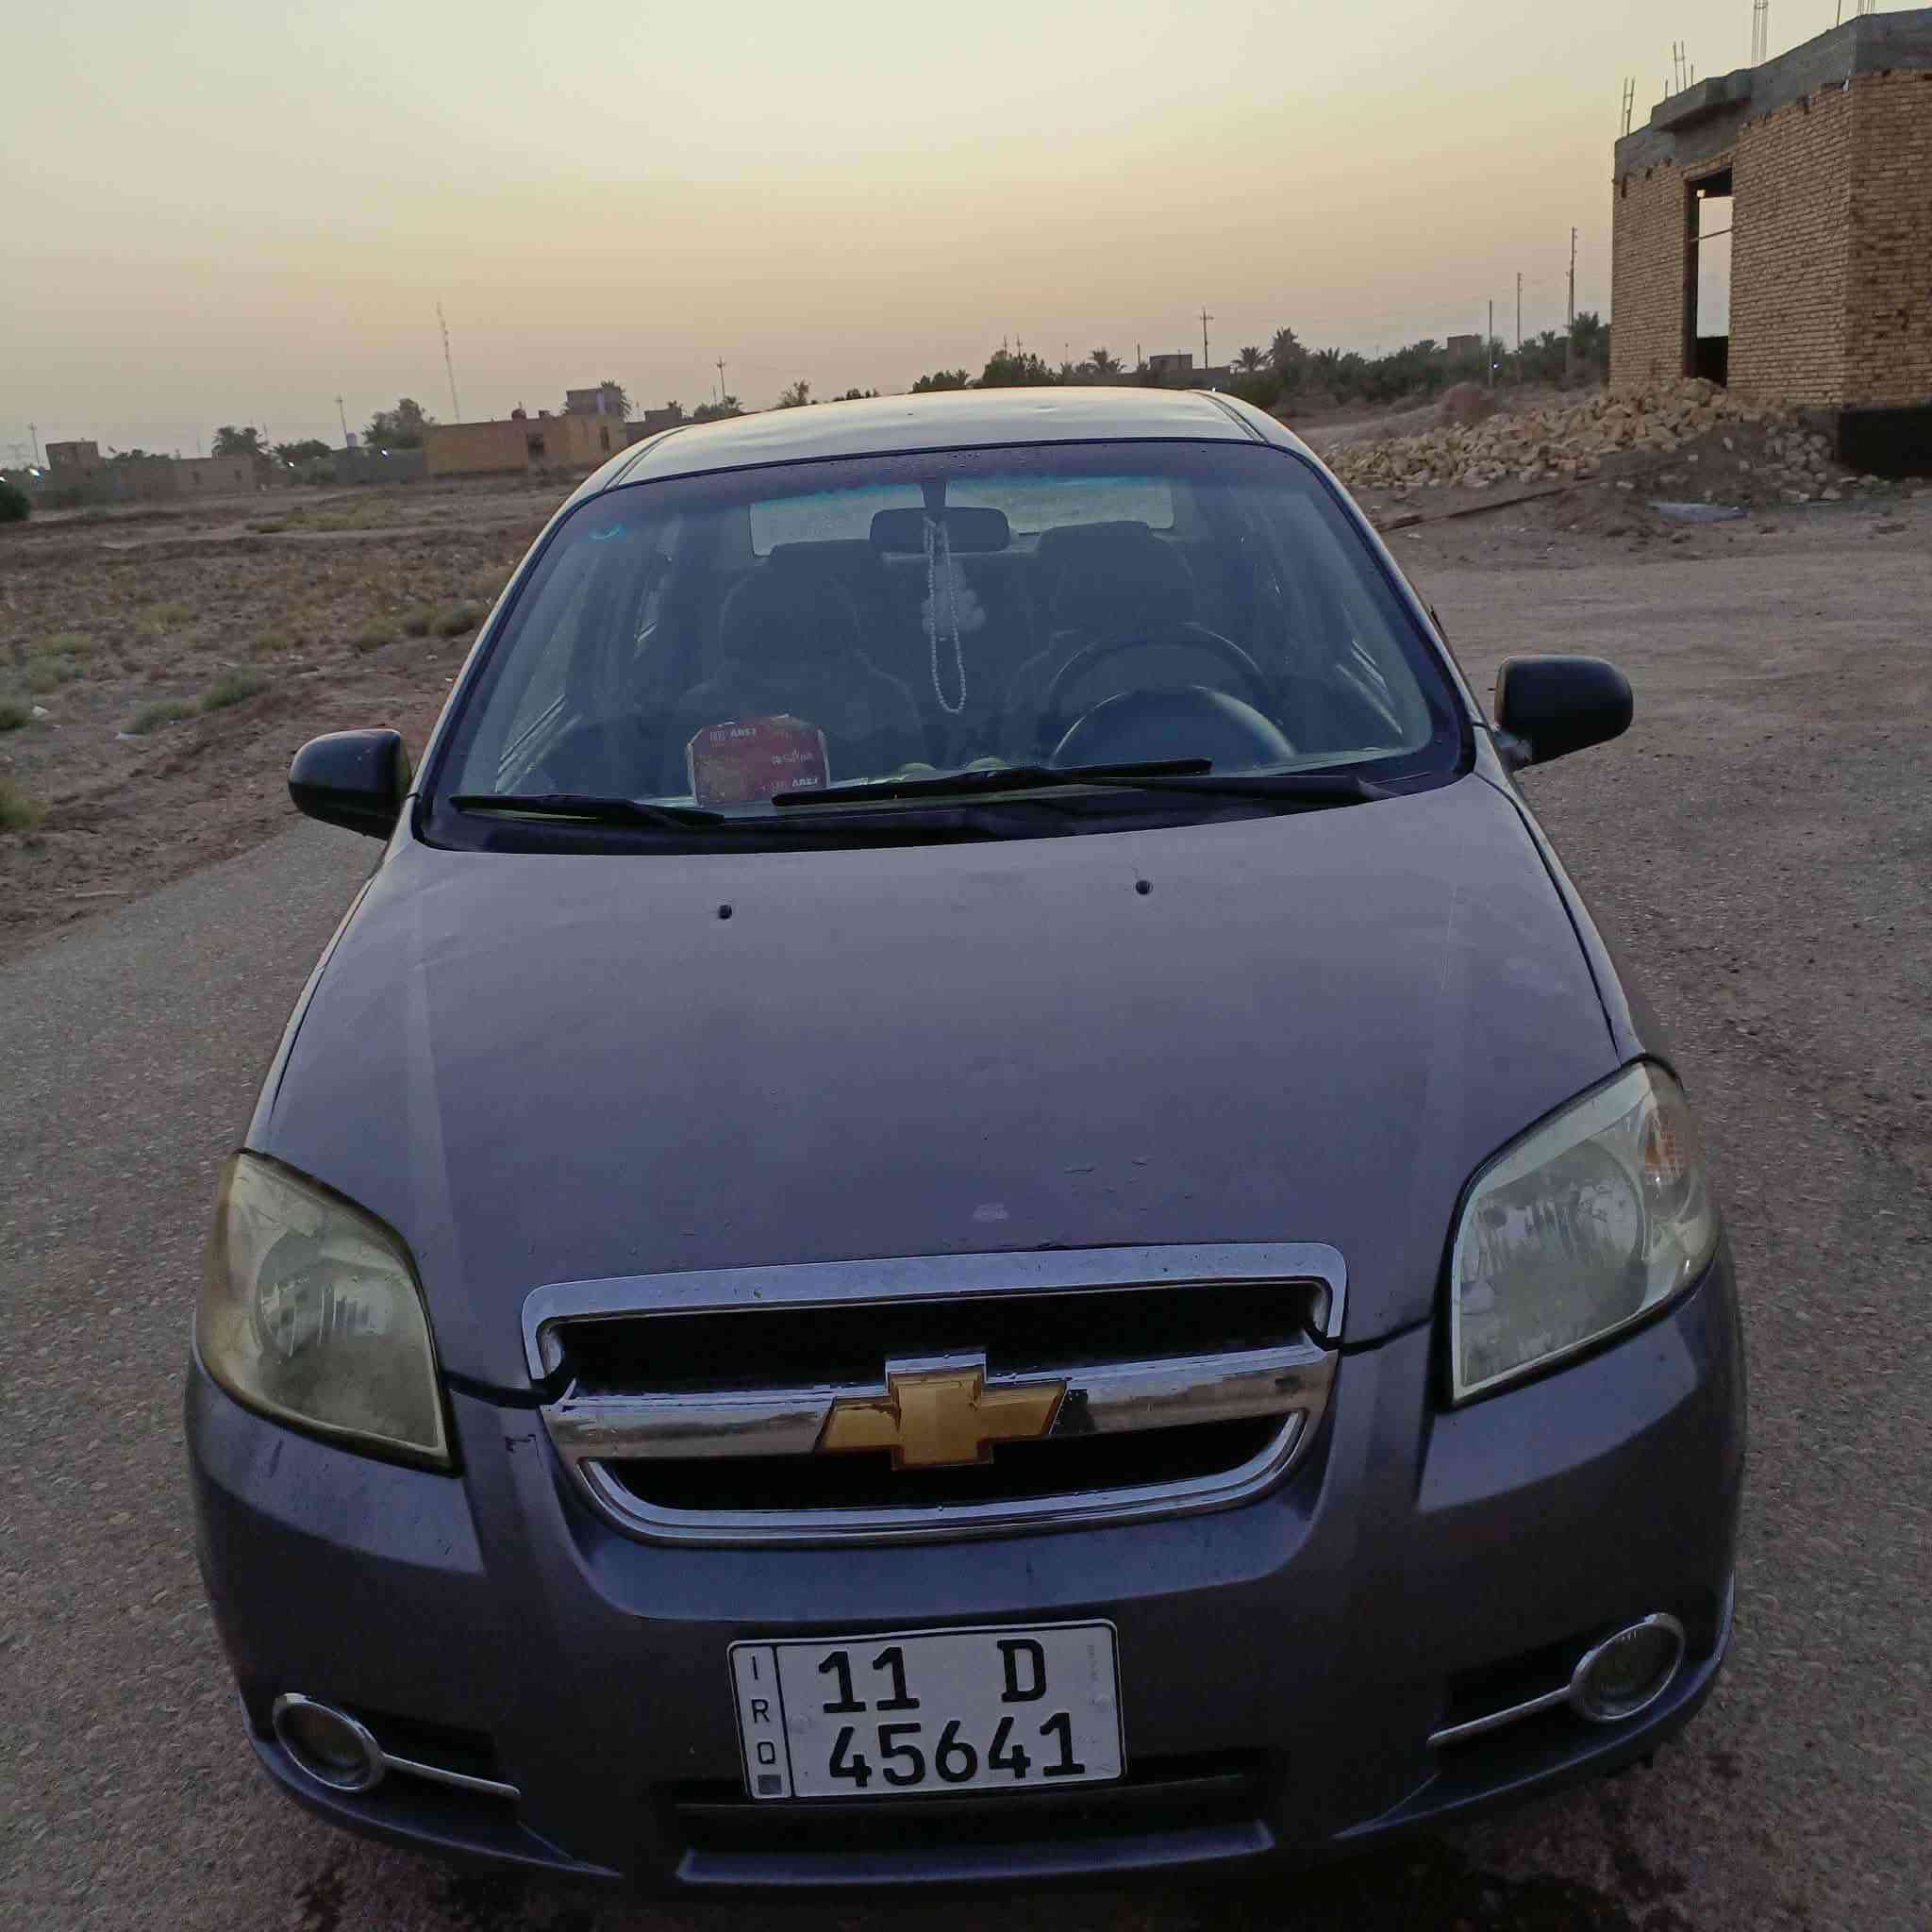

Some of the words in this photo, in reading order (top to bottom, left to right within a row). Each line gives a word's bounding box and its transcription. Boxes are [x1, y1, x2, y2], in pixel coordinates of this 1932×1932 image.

[751, 1655, 775, 1764] IRQ
[818, 1645, 920, 1713] 11
[996, 1639, 1046, 1703] D
[829, 1712, 1085, 1788] 45641
